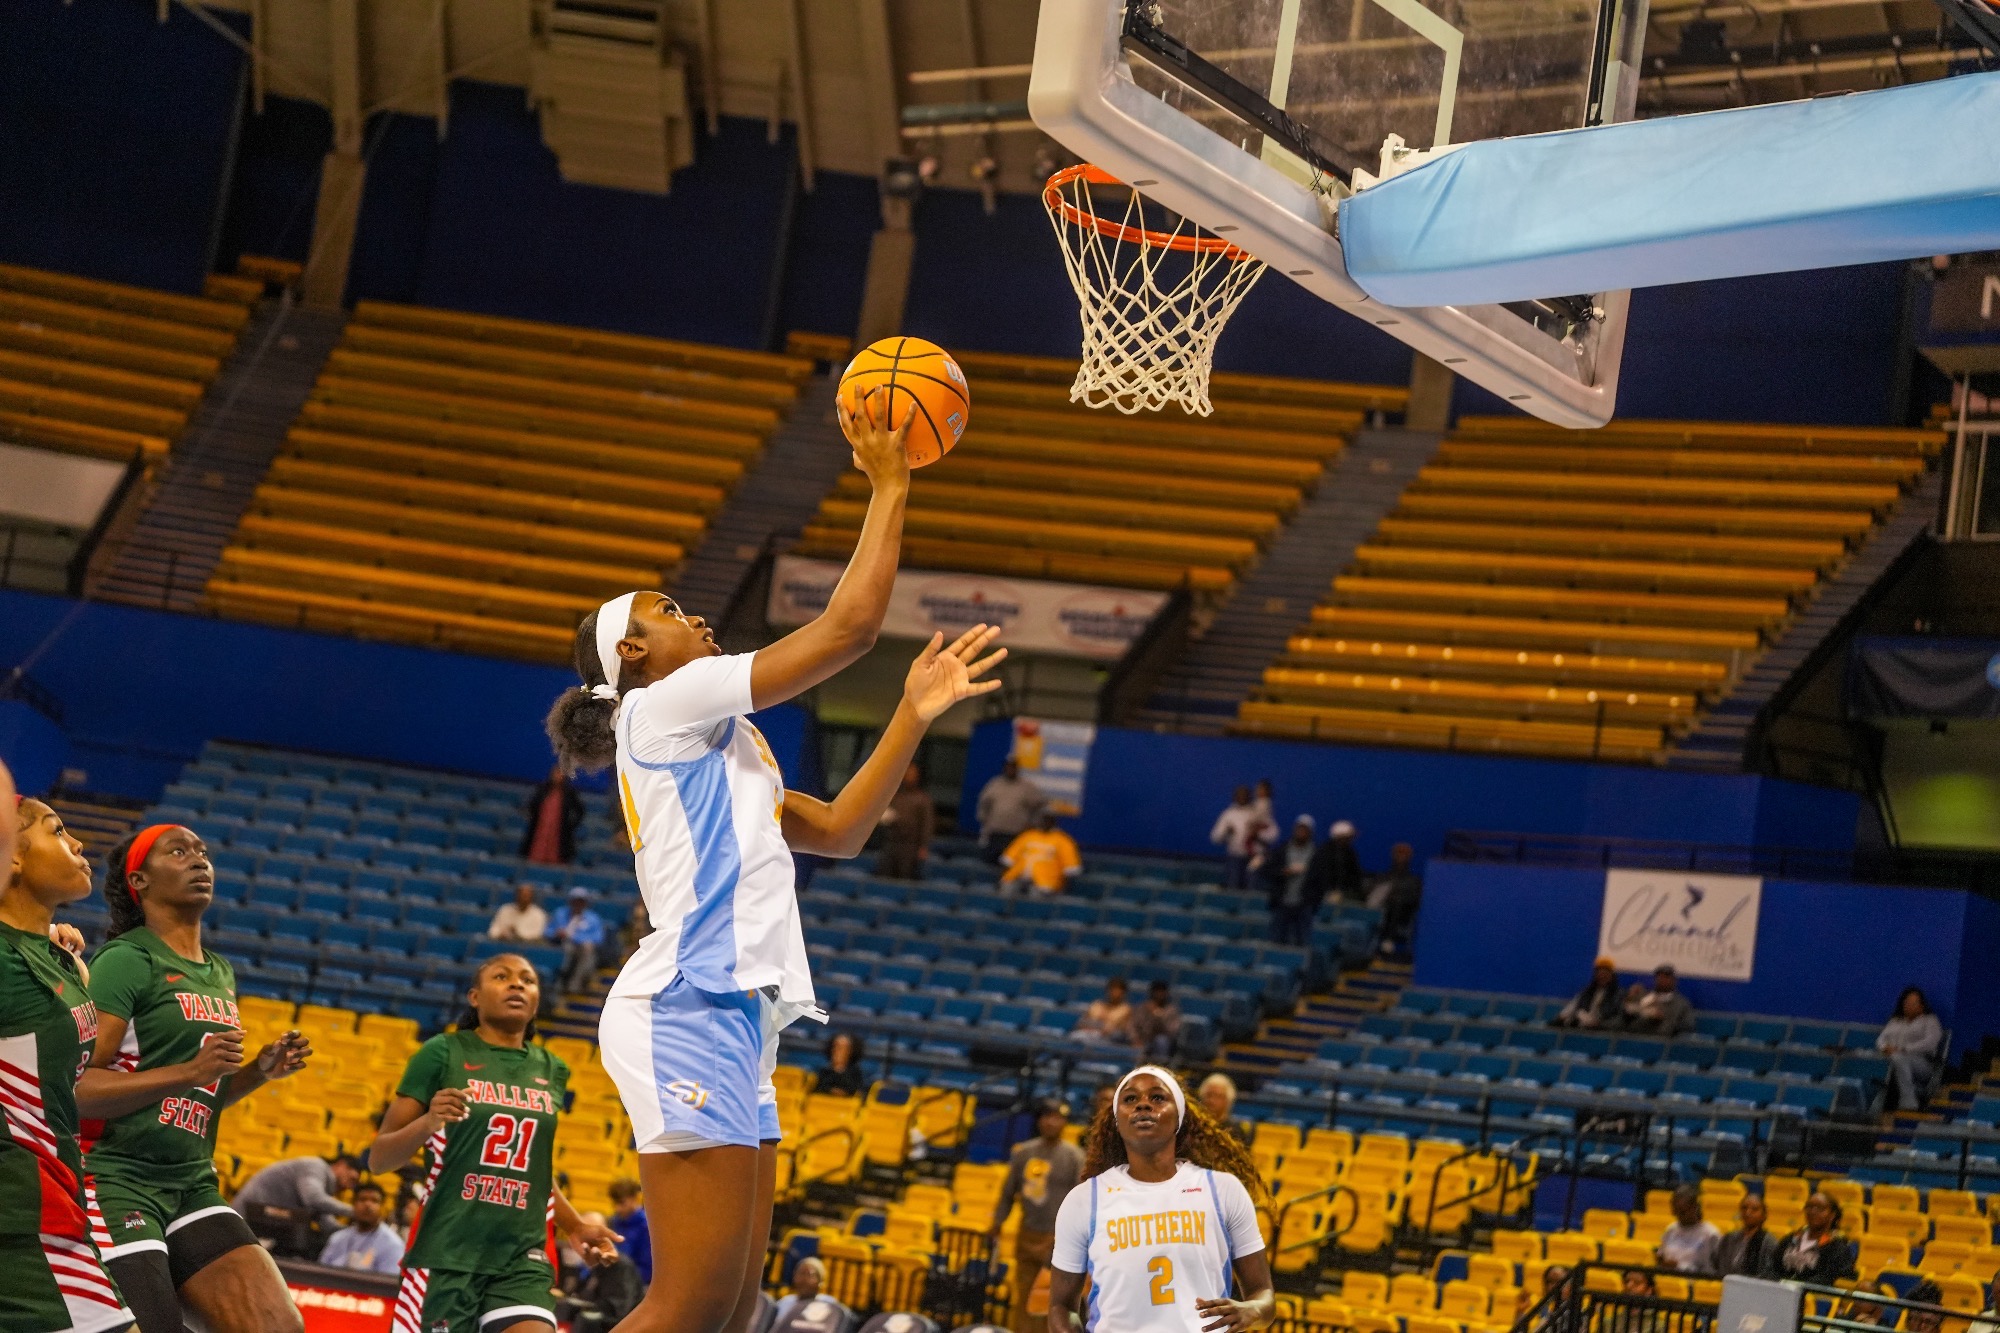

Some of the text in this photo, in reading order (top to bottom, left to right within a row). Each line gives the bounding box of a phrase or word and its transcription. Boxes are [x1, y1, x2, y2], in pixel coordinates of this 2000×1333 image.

[467, 1078, 554, 1115] VALLEY
[480, 1112, 538, 1172] 21
[461, 1173, 531, 1210] STATE
[1106, 1210, 1206, 1253] SOUTHERN
[1147, 1255, 1176, 1307] 2
